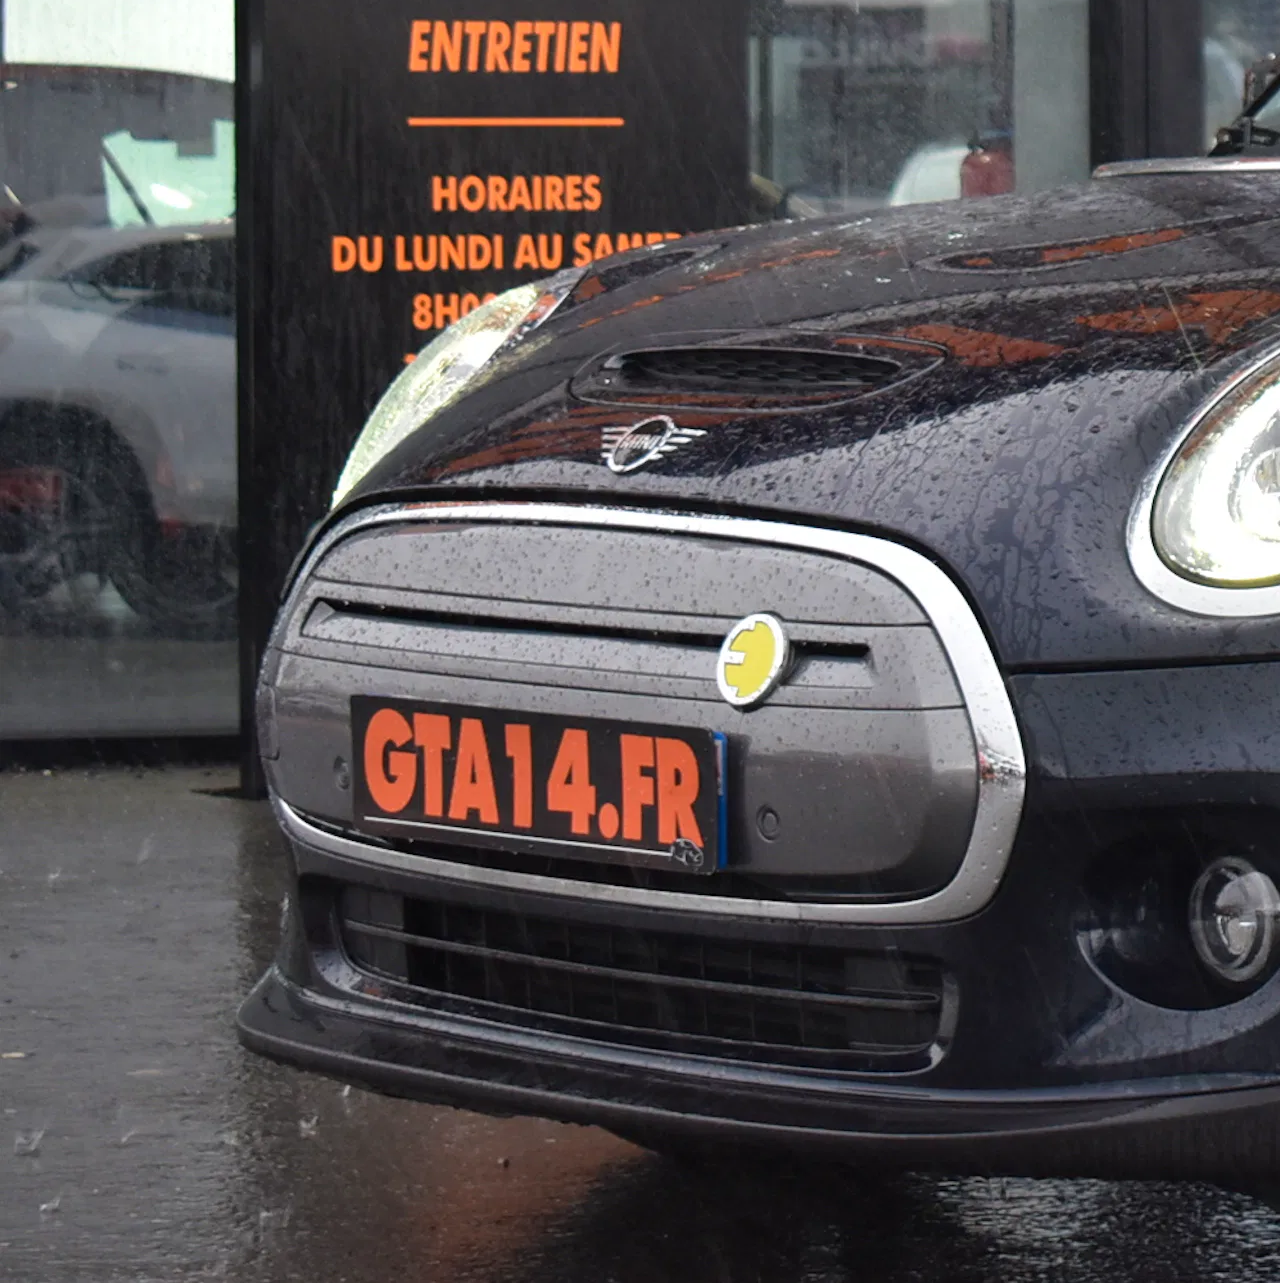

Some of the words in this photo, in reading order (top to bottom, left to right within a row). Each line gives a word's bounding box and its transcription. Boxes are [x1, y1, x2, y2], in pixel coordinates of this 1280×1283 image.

[407, 19, 622, 74] ENTRETIEN
[431, 173, 603, 213] HORAIRES
[331, 235, 384, 273] DU
[394, 233, 504, 273] LUNDI
[513, 232, 564, 272] AU
[363, 707, 704, 849] GTA14.FR
